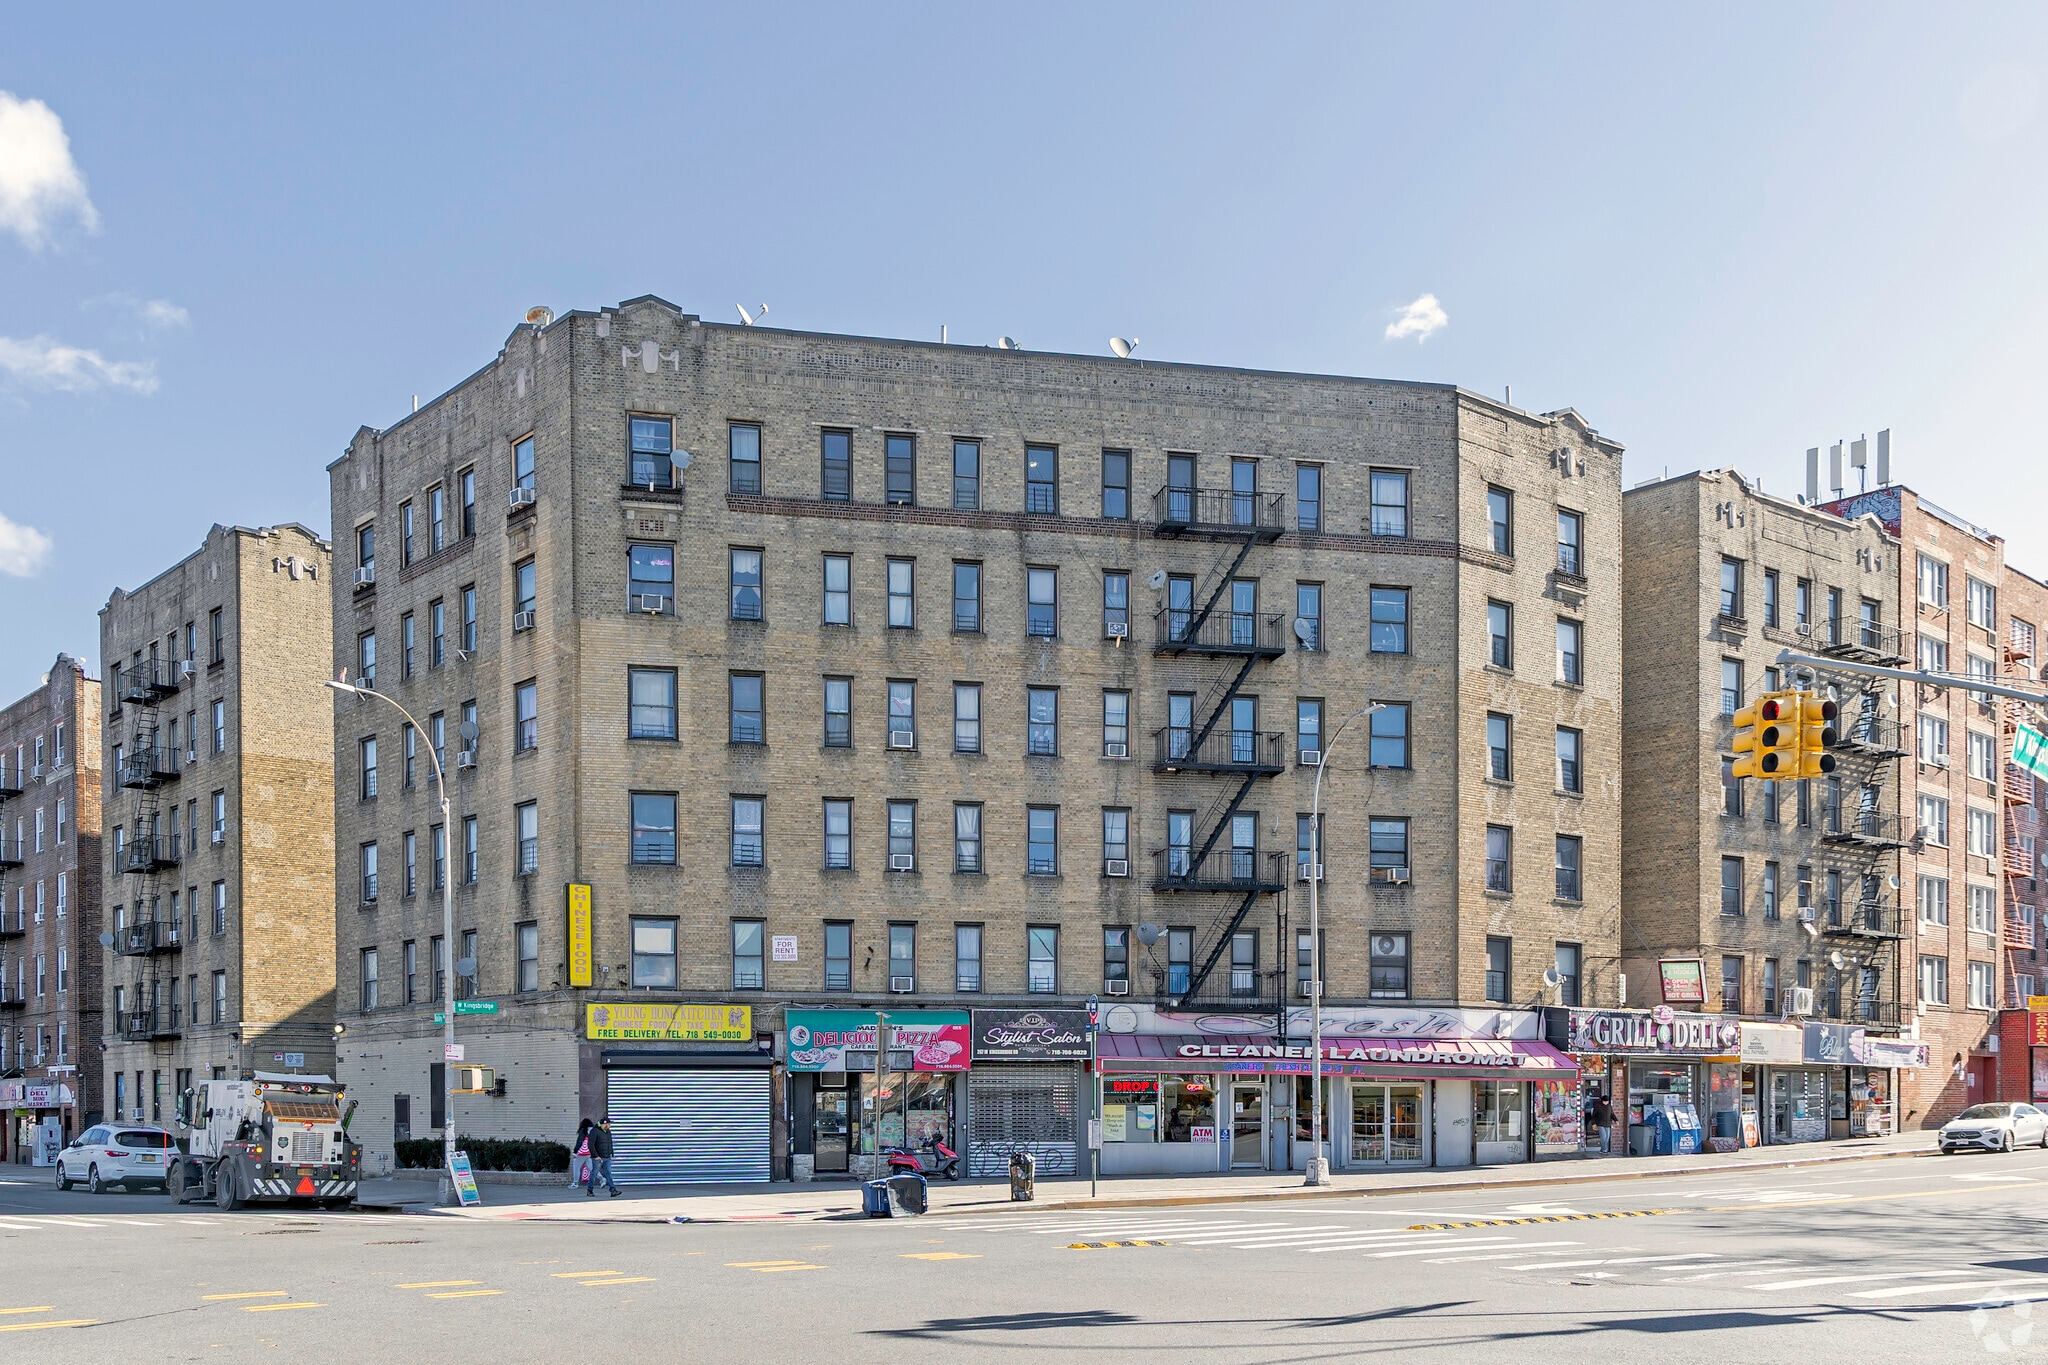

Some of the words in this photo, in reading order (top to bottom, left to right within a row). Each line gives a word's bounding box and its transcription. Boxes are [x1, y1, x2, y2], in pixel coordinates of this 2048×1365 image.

[463, 1002, 494, 1010] Kingsbridge
[613, 1007, 647, 1019] YOUNG
[652, 1008, 677, 1019] HONG
[680, 1009, 724, 1020] KITCHEN
[612, 1021, 643, 1029] CHINESE
[648, 1021, 667, 1029] FOOD
[673, 1022, 682, 1030] TO
[687, 1022, 705, 1030] TAKE
[709, 1022, 724, 1030] OUT
[598, 1029, 618, 1038] FREE
[624, 1030, 661, 1039] DELIVERY
[686, 1030, 699, 1039] 718
[704, 1030, 741, 1039] 549-0030
[983, 1027, 1040, 1047] Stylist
[1594, 1016, 1657, 1047] GRILL
[1673, 1020, 1719, 1048] DELI
[896, 1031, 942, 1048] PIZZA
[1329, 1046, 1527, 1066] LAUNDROMAT
[1113, 1081, 1150, 1092] DROP
[1192, 1129, 1213, 1137] ATM
